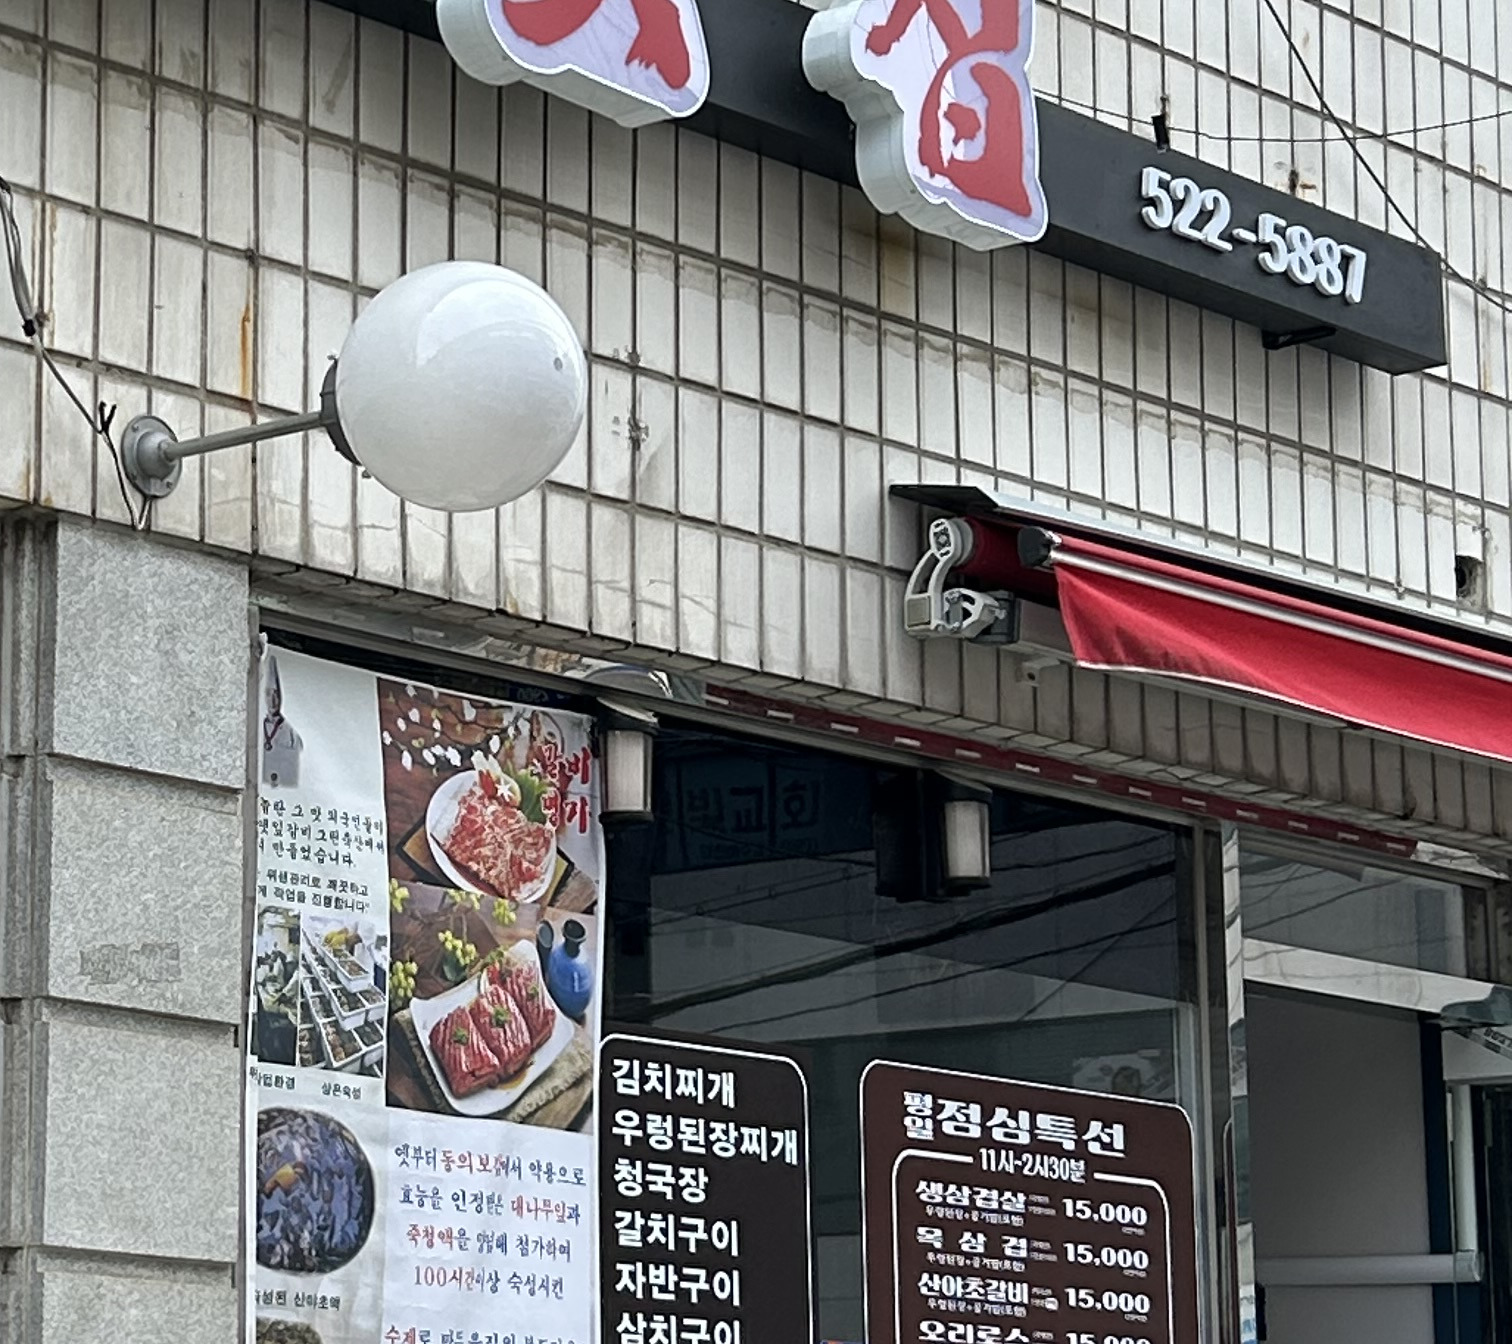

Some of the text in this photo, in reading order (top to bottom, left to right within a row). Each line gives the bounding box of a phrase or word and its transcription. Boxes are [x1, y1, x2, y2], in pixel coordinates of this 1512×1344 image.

[1140, 165, 1368, 305] 522-5887
[611, 1058, 736, 1109] 김치찌개
[611, 1109, 800, 1166] 우렁된장찌개
[903, 1091, 1127, 1158] 평일 점심특선
[394, 1143, 437, 1172] 옛부터
[528, 1159, 587, 1186] 약용으로
[613, 1158, 709, 1203] 청국장
[399, 1184, 443, 1211] 효능을
[510, 1194, 581, 1227] 대나무잎과
[915, 1179, 1149, 1227] 생삼겹살 15,000
[613, 1211, 740, 1257] 갈치구이
[1063, 1241, 1149, 1270] 15,000
[507, 1271, 564, 1301] 숙성시킨
[615, 1262, 742, 1307] 자반구이
[917, 1272, 1029, 1305] 산야초갈비
[1064, 1287, 1151, 1314] 15,000
